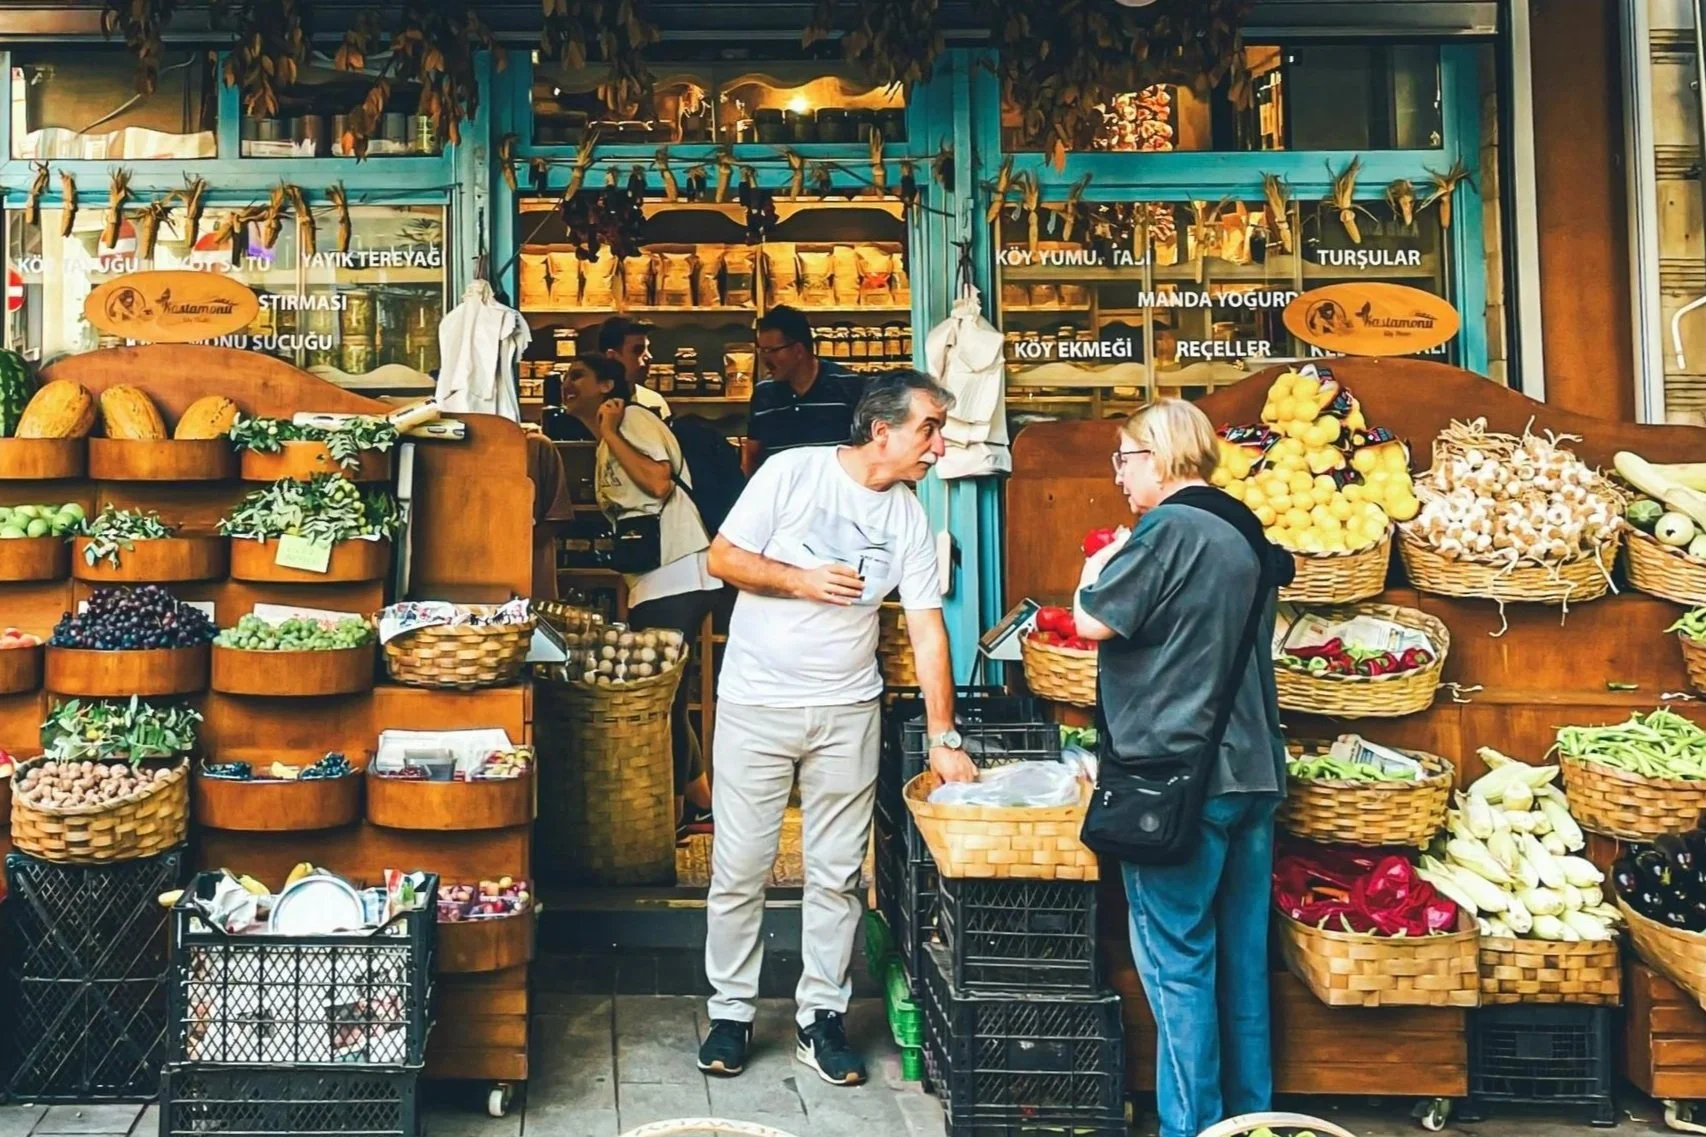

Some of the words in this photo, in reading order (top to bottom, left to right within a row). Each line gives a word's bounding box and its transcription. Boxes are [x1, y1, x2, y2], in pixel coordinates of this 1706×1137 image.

[302, 251, 354, 268] YAYIK
[995, 246, 1033, 266] KÖY
[1317, 249, 1421, 270] TURŞULAR
[1138, 291, 1212, 308] MANDA
[252, 331, 332, 351] SUCUĞU
[1014, 338, 1055, 358] KÖY
[1058, 337, 1133, 358] EKMEĞİ
[1177, 340, 1272, 361] REÇELLER
